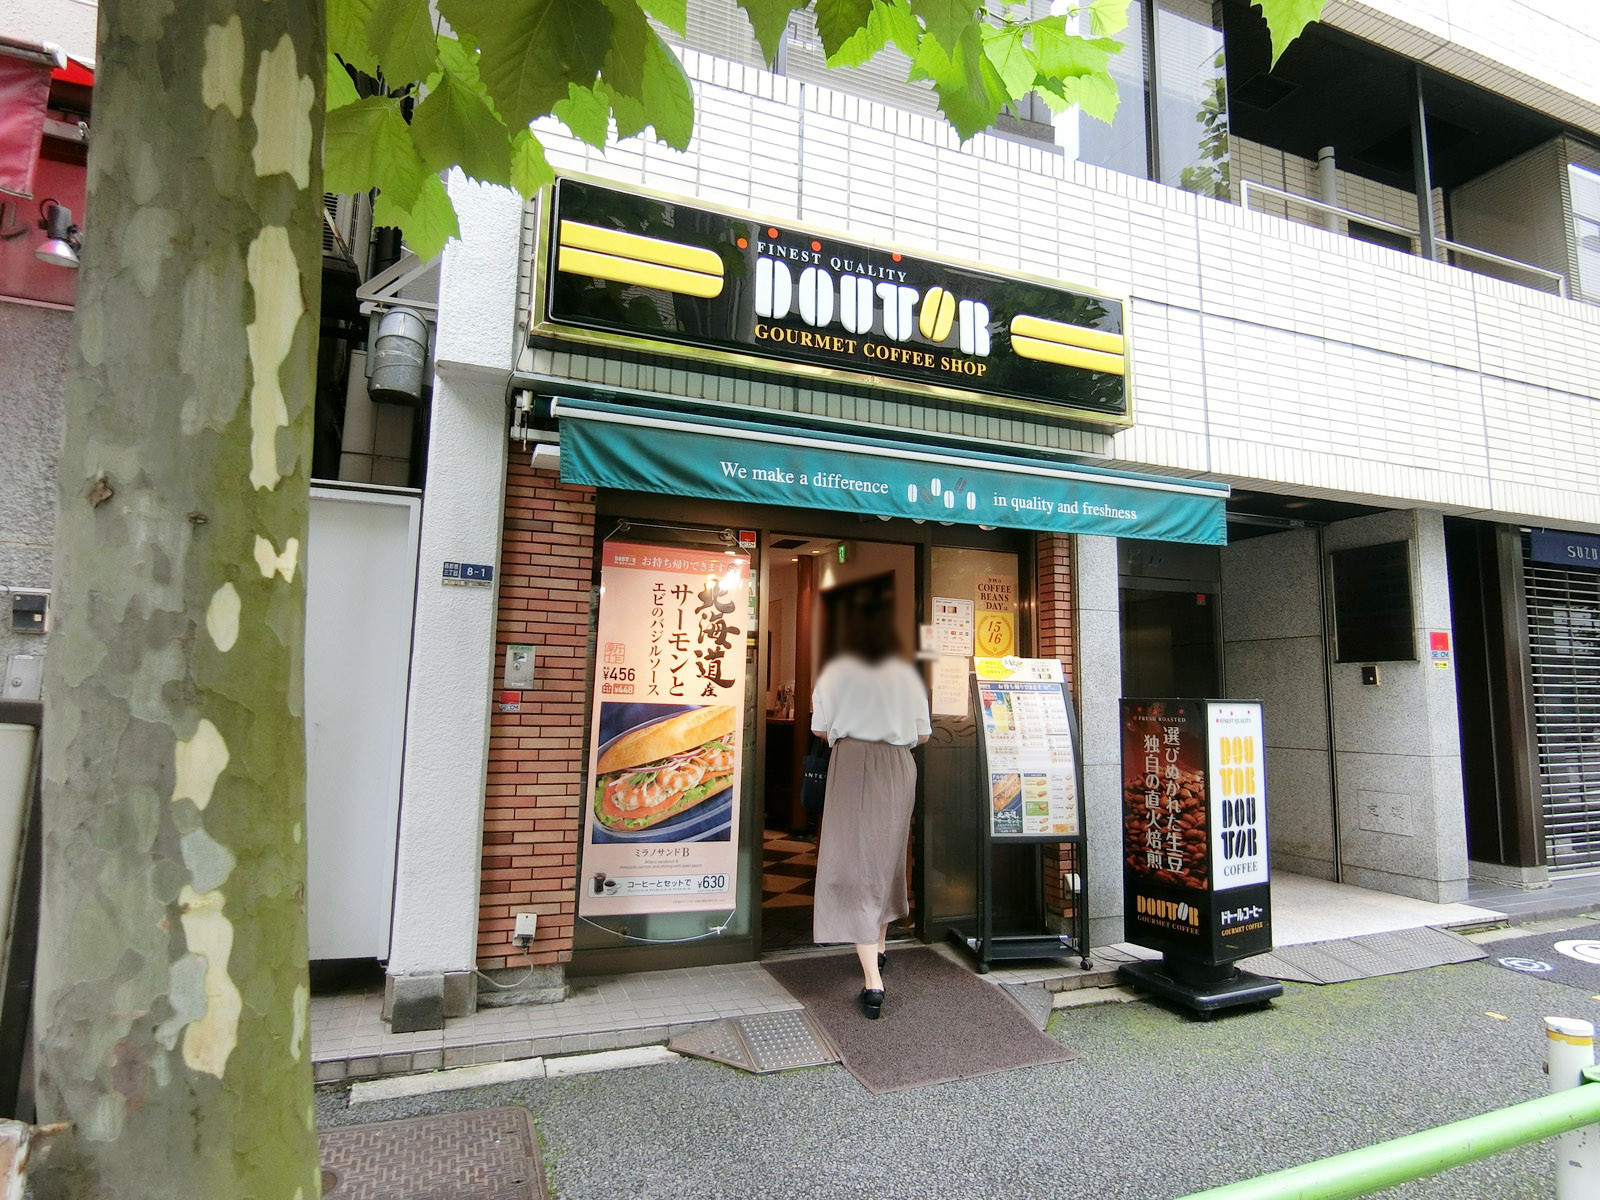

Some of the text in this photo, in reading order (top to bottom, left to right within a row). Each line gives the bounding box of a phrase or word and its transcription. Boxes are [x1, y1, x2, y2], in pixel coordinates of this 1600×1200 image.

[757, 241, 907, 283] FINEST QUALITY
[755, 257, 991, 357] DOUTOR
[754, 324, 987, 377] GOURMET COFFEE SHOP
[720, 461, 889, 494] We make a difference
[993, 492, 1137, 520] in quality and freshness
[467, 567, 486, 577] 8-1
[642, 556, 726, 574] お持ち帰りできます
[977, 583, 1012, 593] COFFEE
[980, 592, 1009, 602] BEANS
[988, 621, 1002, 633] 15
[646, 582, 666, 697] エビのバジルソース
[668, 584, 693, 697] サーモンと
[988, 632, 1003, 644] 16
[603, 667, 636, 681] ¥456
[1144, 734, 1163, 870] 独自の直火焙煎
[1163, 726, 1184, 874] 選びぬかれた生豆
[1224, 861, 1257, 876] COFFEE
[627, 875, 725, 889] コーヒーとセットで ¥630
[1137, 895, 1199, 927] DOUTOR
[1221, 905, 1263, 925] ドトールコーヒー
[1137, 914, 1200, 936] GOURMET COFFEE
[1221, 922, 1263, 937] GOURMET COFFEE
